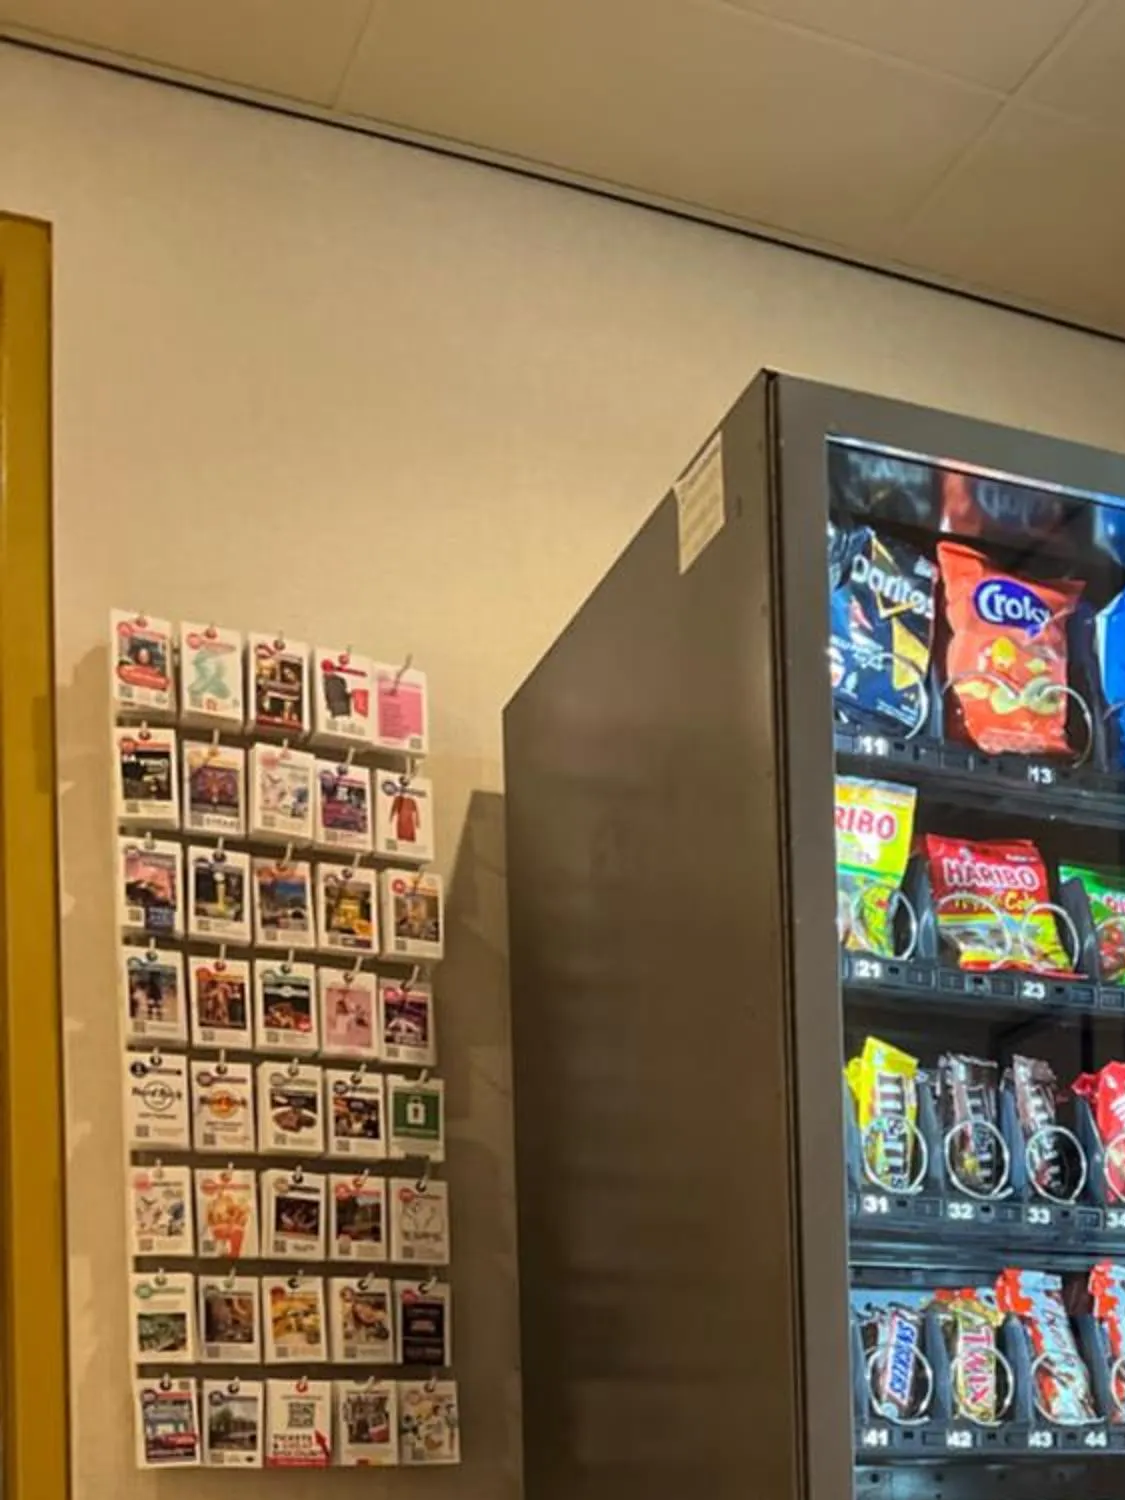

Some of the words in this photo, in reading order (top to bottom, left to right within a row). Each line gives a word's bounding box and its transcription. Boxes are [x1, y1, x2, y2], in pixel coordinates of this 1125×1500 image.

[942, 857, 1040, 892] HARIBO
[855, 962, 882, 978] 21
[1022, 981, 1046, 998] 23
[863, 1196, 889, 1213] 31
[948, 1203, 975, 1220] 32
[1027, 1207, 1051, 1224] 33
[864, 1429, 889, 1446] 41
[947, 1430, 973, 1447] 42
[1029, 1430, 1053, 1448] 43
[1084, 1430, 1107, 1447] 44
